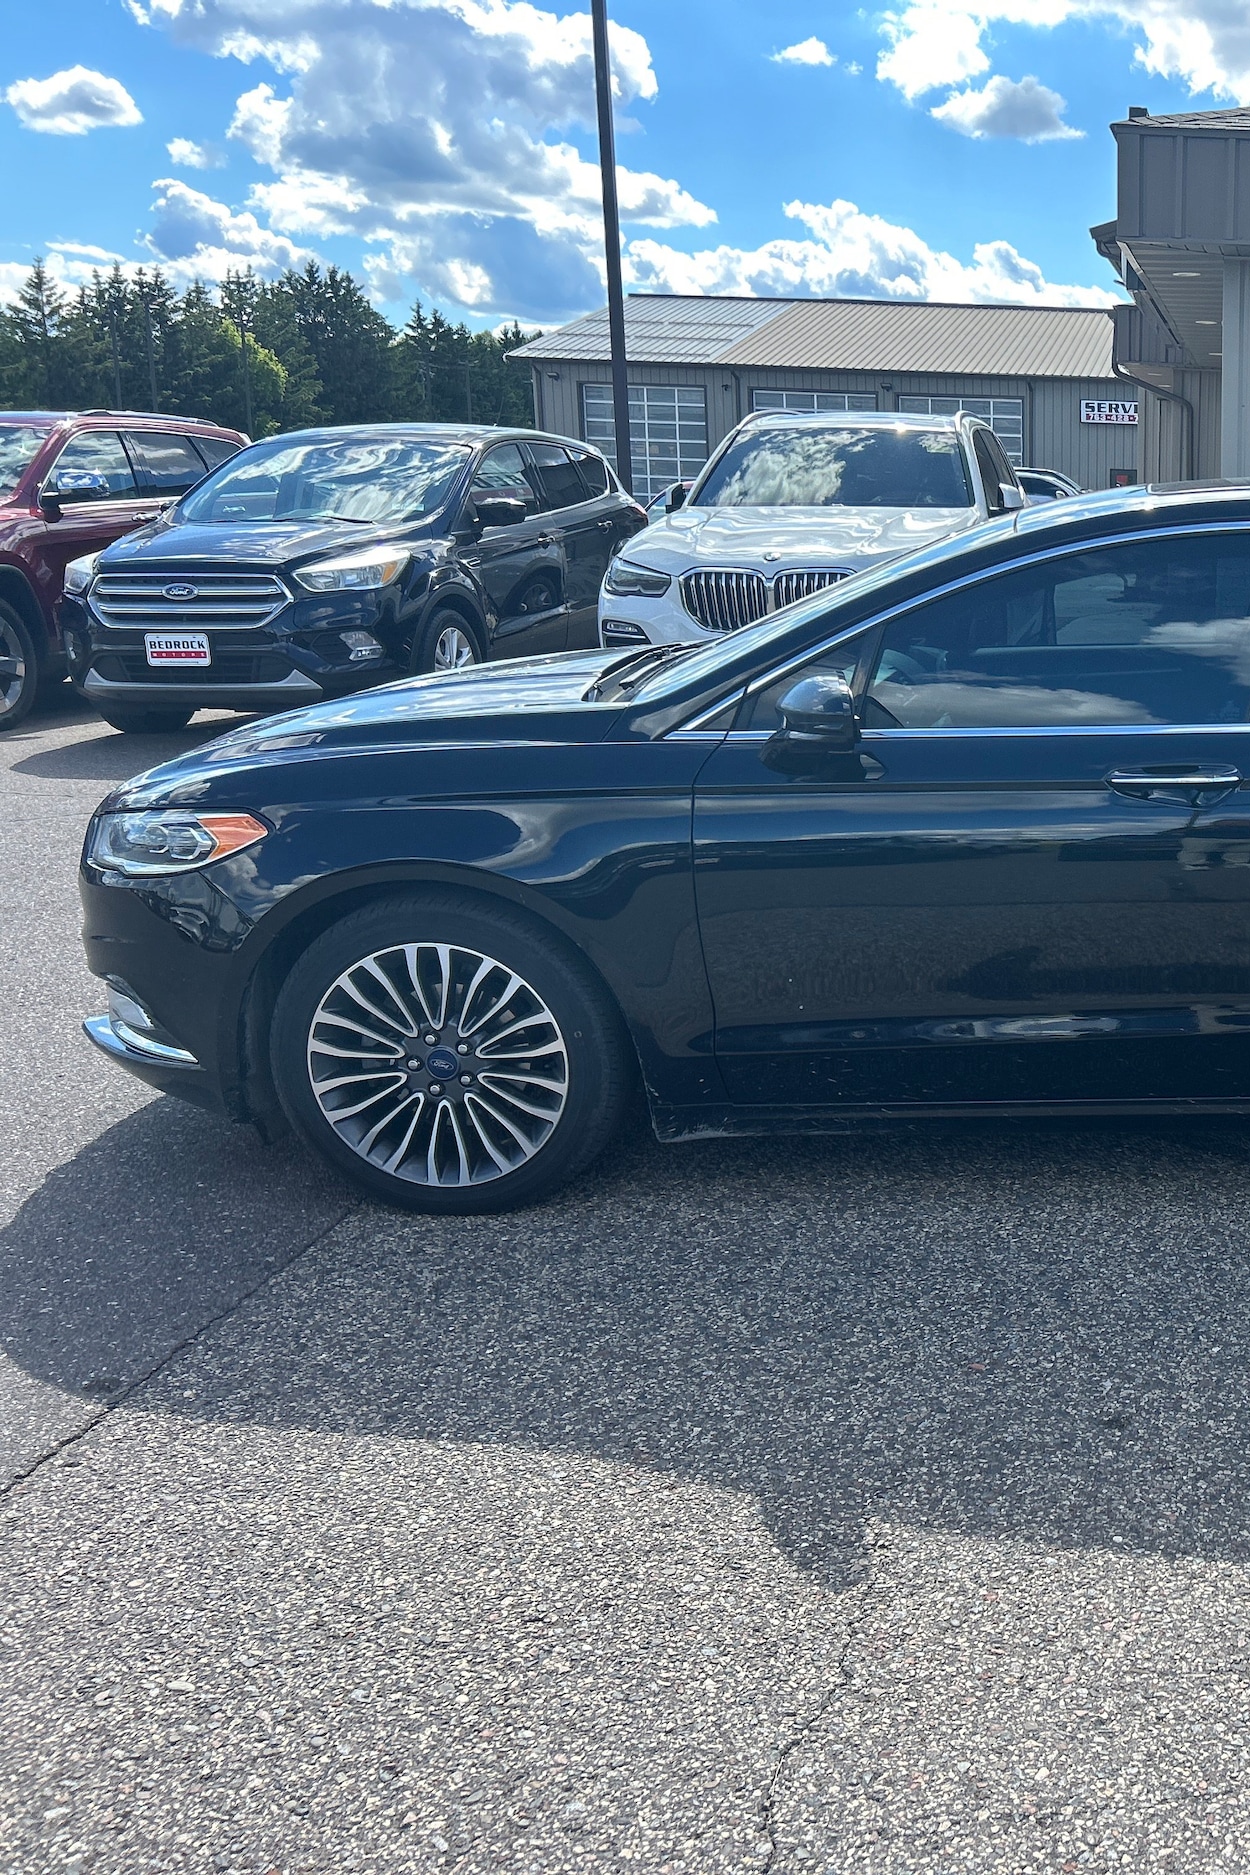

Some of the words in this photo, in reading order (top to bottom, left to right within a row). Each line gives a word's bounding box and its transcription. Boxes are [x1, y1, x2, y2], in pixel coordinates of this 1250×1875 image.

[1085, 402, 1138, 414] SERVI
[169, 587, 190, 596] Ford
[149, 640, 206, 650] BEDROCK
